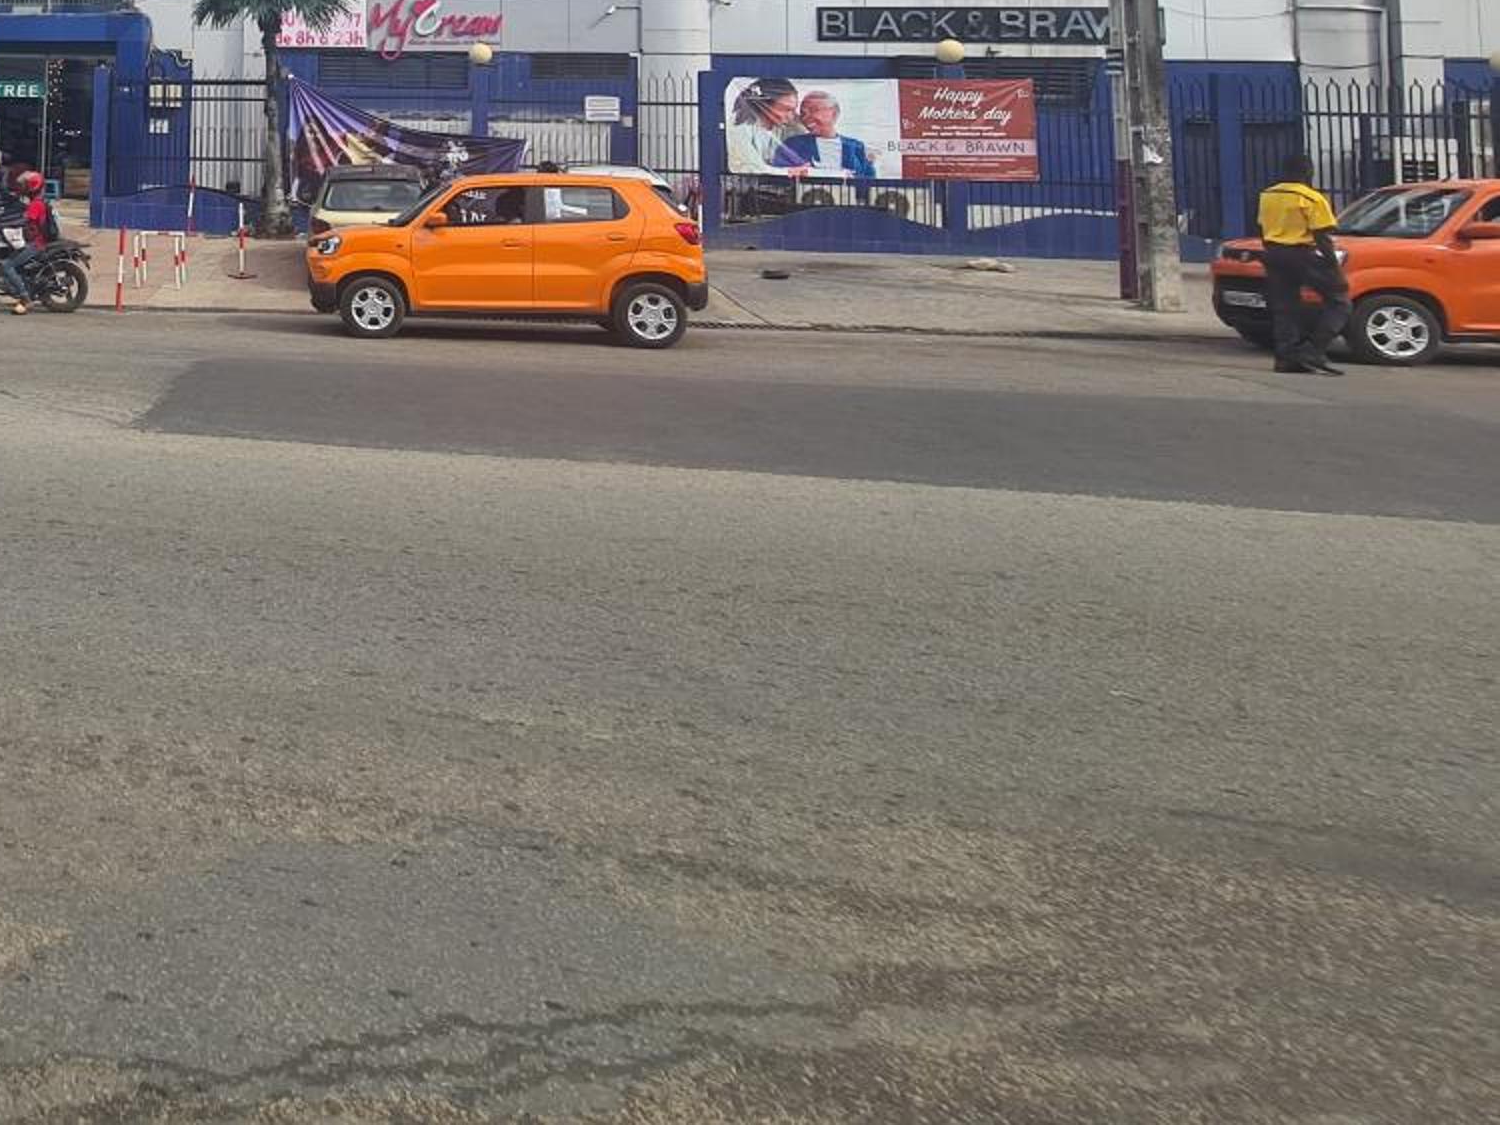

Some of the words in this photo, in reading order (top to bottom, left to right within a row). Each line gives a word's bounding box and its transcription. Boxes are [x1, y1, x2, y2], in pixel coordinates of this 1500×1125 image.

[821, 10, 957, 38] BLACK
[966, 11, 989, 38] &
[933, 86, 985, 108] Happy
[983, 106, 1013, 126] day
[887, 140, 939, 152] BLACK
[964, 140, 1026, 154] BRAWN
